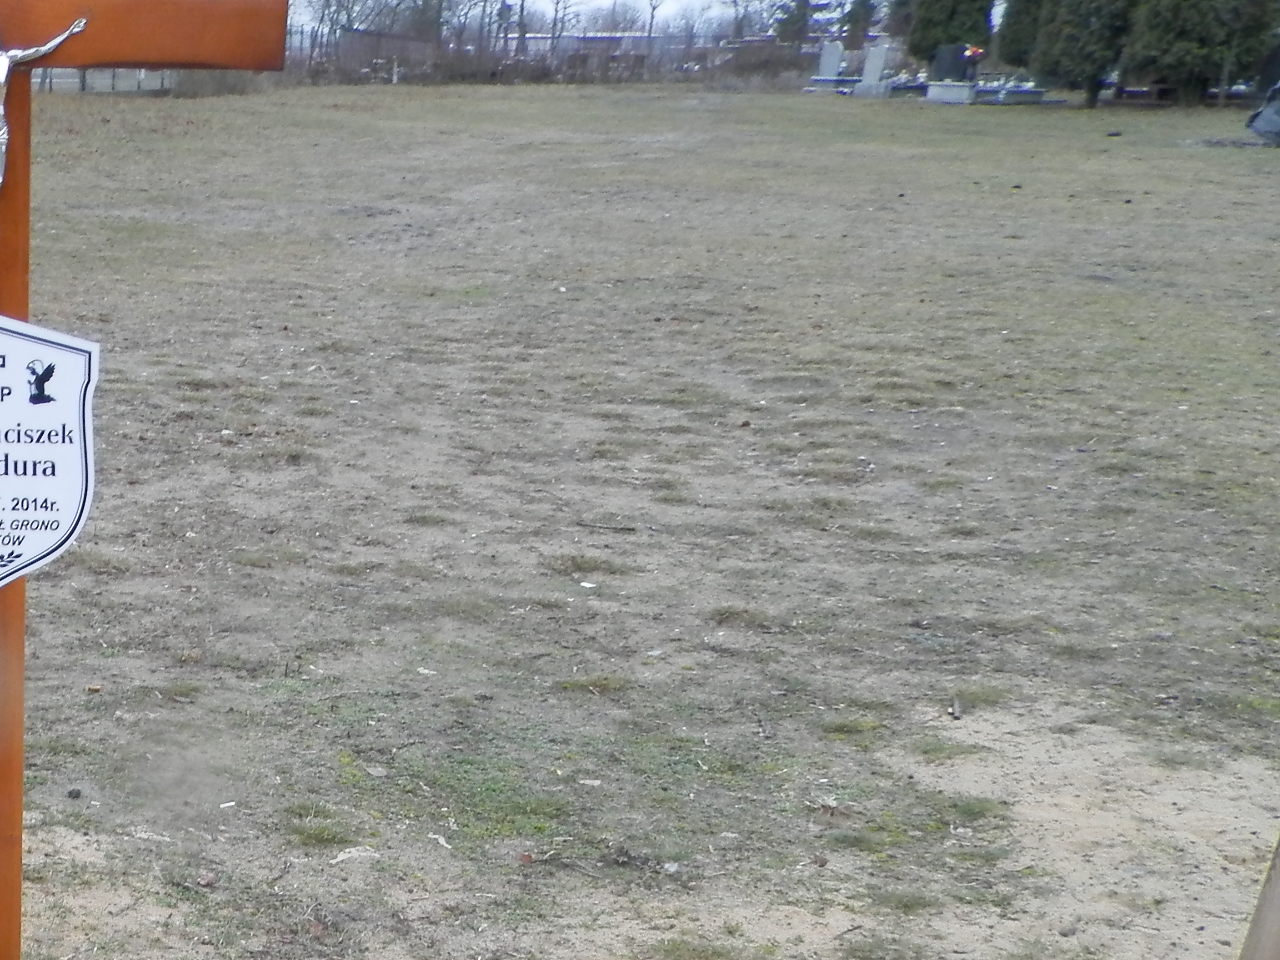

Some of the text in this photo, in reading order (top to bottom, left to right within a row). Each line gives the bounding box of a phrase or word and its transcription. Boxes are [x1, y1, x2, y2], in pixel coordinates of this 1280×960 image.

[0, 386, 12, 402] P
[11, 497, 60, 512] 2014r.
[10, 519, 60, 531] GRONO
